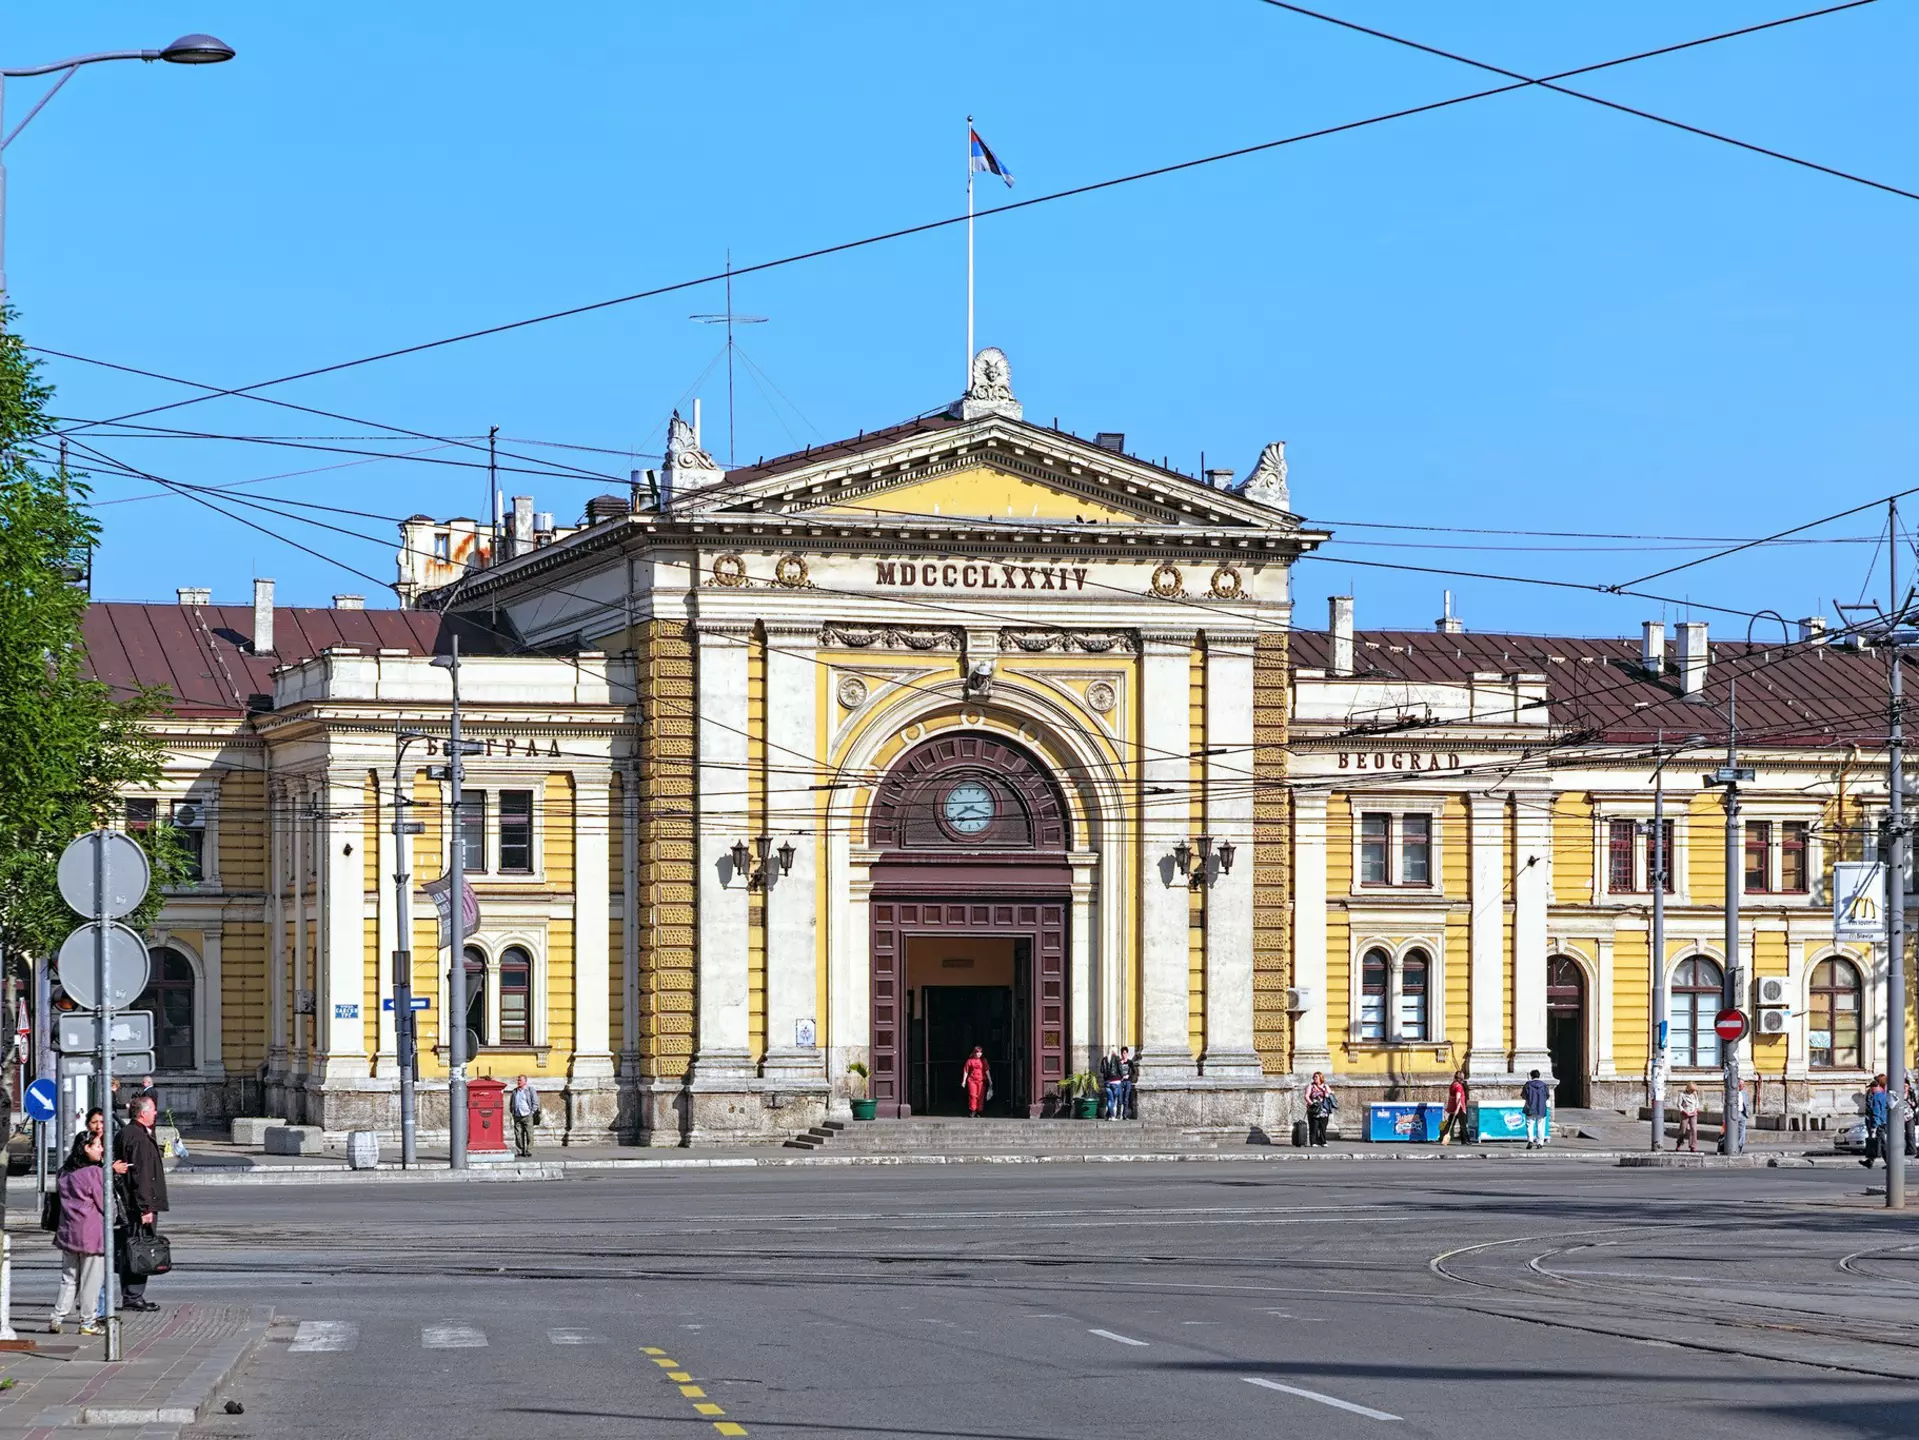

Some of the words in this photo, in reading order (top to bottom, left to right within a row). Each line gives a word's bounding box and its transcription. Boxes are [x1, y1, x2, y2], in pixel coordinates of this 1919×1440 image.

[876, 562, 1088, 590] MDCCCLXXXIV
[427, 738, 562, 757] БГРАД
[1338, 752, 1460, 770] BEOGRAD
